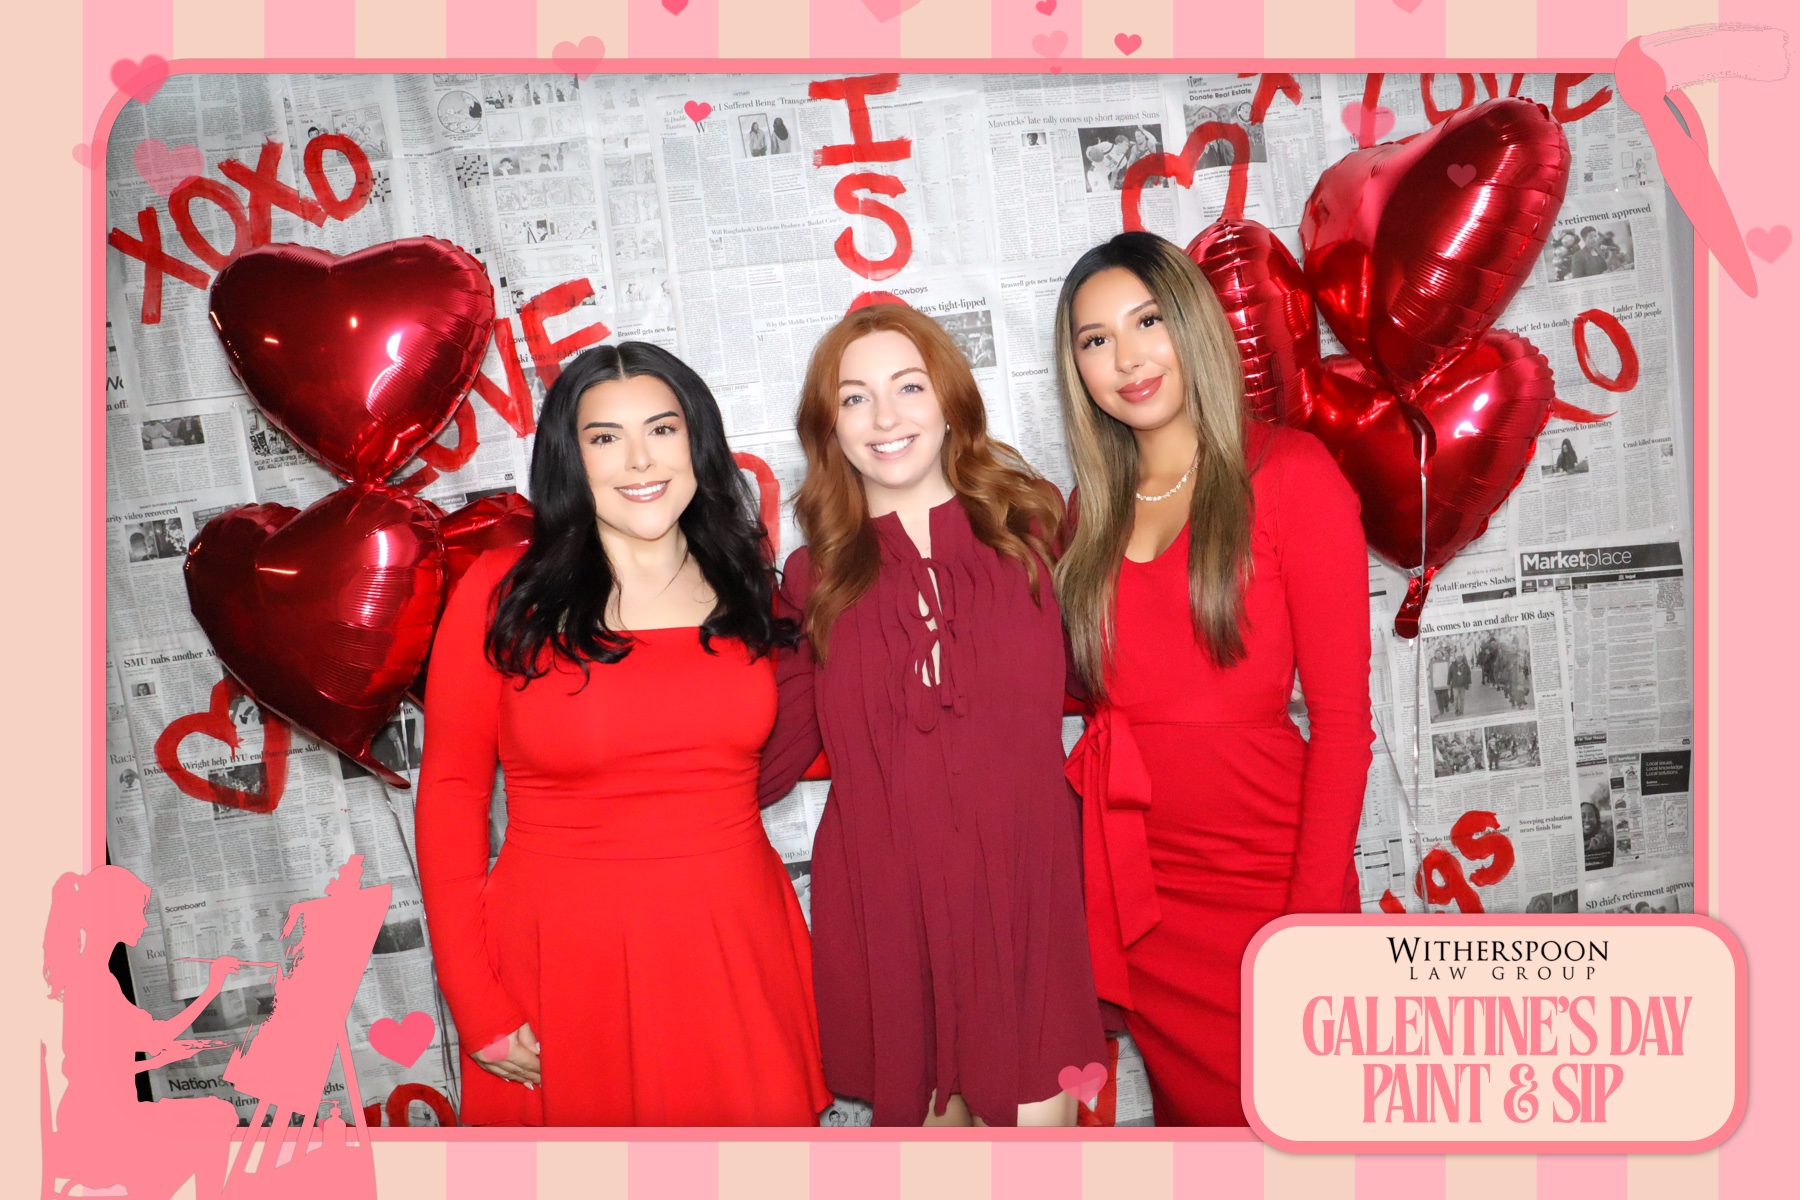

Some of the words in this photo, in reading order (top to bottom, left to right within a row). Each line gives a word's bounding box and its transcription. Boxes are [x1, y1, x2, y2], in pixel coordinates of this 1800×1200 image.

[1189, 92, 1214, 102] Donate
[1214, 90, 1230, 100] Real
[1231, 88, 1253, 97] Estate.
[723, 99, 754, 111] Suffered
[755, 99, 776, 110] Being
[988, 116, 1027, 129] Mavericks'
[1028, 115, 1041, 125] late
[1042, 114, 1058, 126] rally
[1059, 115, 1082, 124] comes
[1083, 115, 1094, 125] up
[1094, 112, 1113, 122] short
[1115, 111, 1140, 123] against
[1141, 110, 1160, 120] Suns
[1563, 212, 1610, 228] retirement
[1611, 204, 1652, 224] approved
[711, 228, 723, 236] Will
[757, 223, 780, 232] Elections
[1025, 280, 1036, 288] gets
[938, 296, 987, 312] tight-lipped
[1612, 304, 1634, 314] Ladder
[1635, 301, 1656, 312] Project
[1612, 313, 1633, 323] helped
[1633, 311, 1643, 319] 50
[1643, 308, 1662, 319] people
[1530, 322, 1542, 331] led
[1543, 321, 1551, 329] to
[1551, 318, 1570, 330] deadly
[642, 328, 654, 337] gets
[1011, 367, 1049, 378] Scoreboard
[1546, 423, 1580, 436] coursework
[1588, 420, 1613, 431] industry
[1622, 441, 1637, 450] Crash
[1637, 438, 1651, 448] killed
[1651, 436, 1672, 444] woman
[124, 511, 144, 522] video
[144, 506, 179, 518] recovered
[1522, 548, 1632, 571] Marketplace
[1435, 578, 1488, 593] TotalEnergies
[1489, 575, 1516, 586] Slashes
[1436, 622, 1461, 632] comes
[1462, 621, 1471, 629] to
[1484, 616, 1499, 626] end
[1500, 614, 1519, 624] after
[1521, 611, 1535, 621] 108
[1537, 609, 1555, 622] days
[123, 656, 148, 669] SMU
[150, 653, 171, 666] nabs
[171, 651, 203, 663] another
[181, 759, 210, 772] Wright
[211, 756, 228, 767] help
[229, 752, 248, 764] BYU
[249, 750, 263, 761] end
[304, 743, 321, 753] skid
[1519, 817, 1545, 828] Sweeping
[1545, 814, 1573, 825] evaluation
[1519, 826, 1535, 834] nears
[1535, 824, 1555, 832] finish
[1555, 823, 1563, 831] line
[1422, 835, 1443, 844] Charles
[1585, 901, 1598, 911] SD
[1599, 895, 1621, 908] chief's
[1622, 887, 1664, 902] retirement
[1665, 881, 1694, 894] approve
[165, 900, 206, 914] Scoreboard
[398, 900, 412, 909] FW
[412, 898, 420, 906] to
[168, 1075, 234, 1092] Nation&
[323, 1082, 345, 1095] ghts
